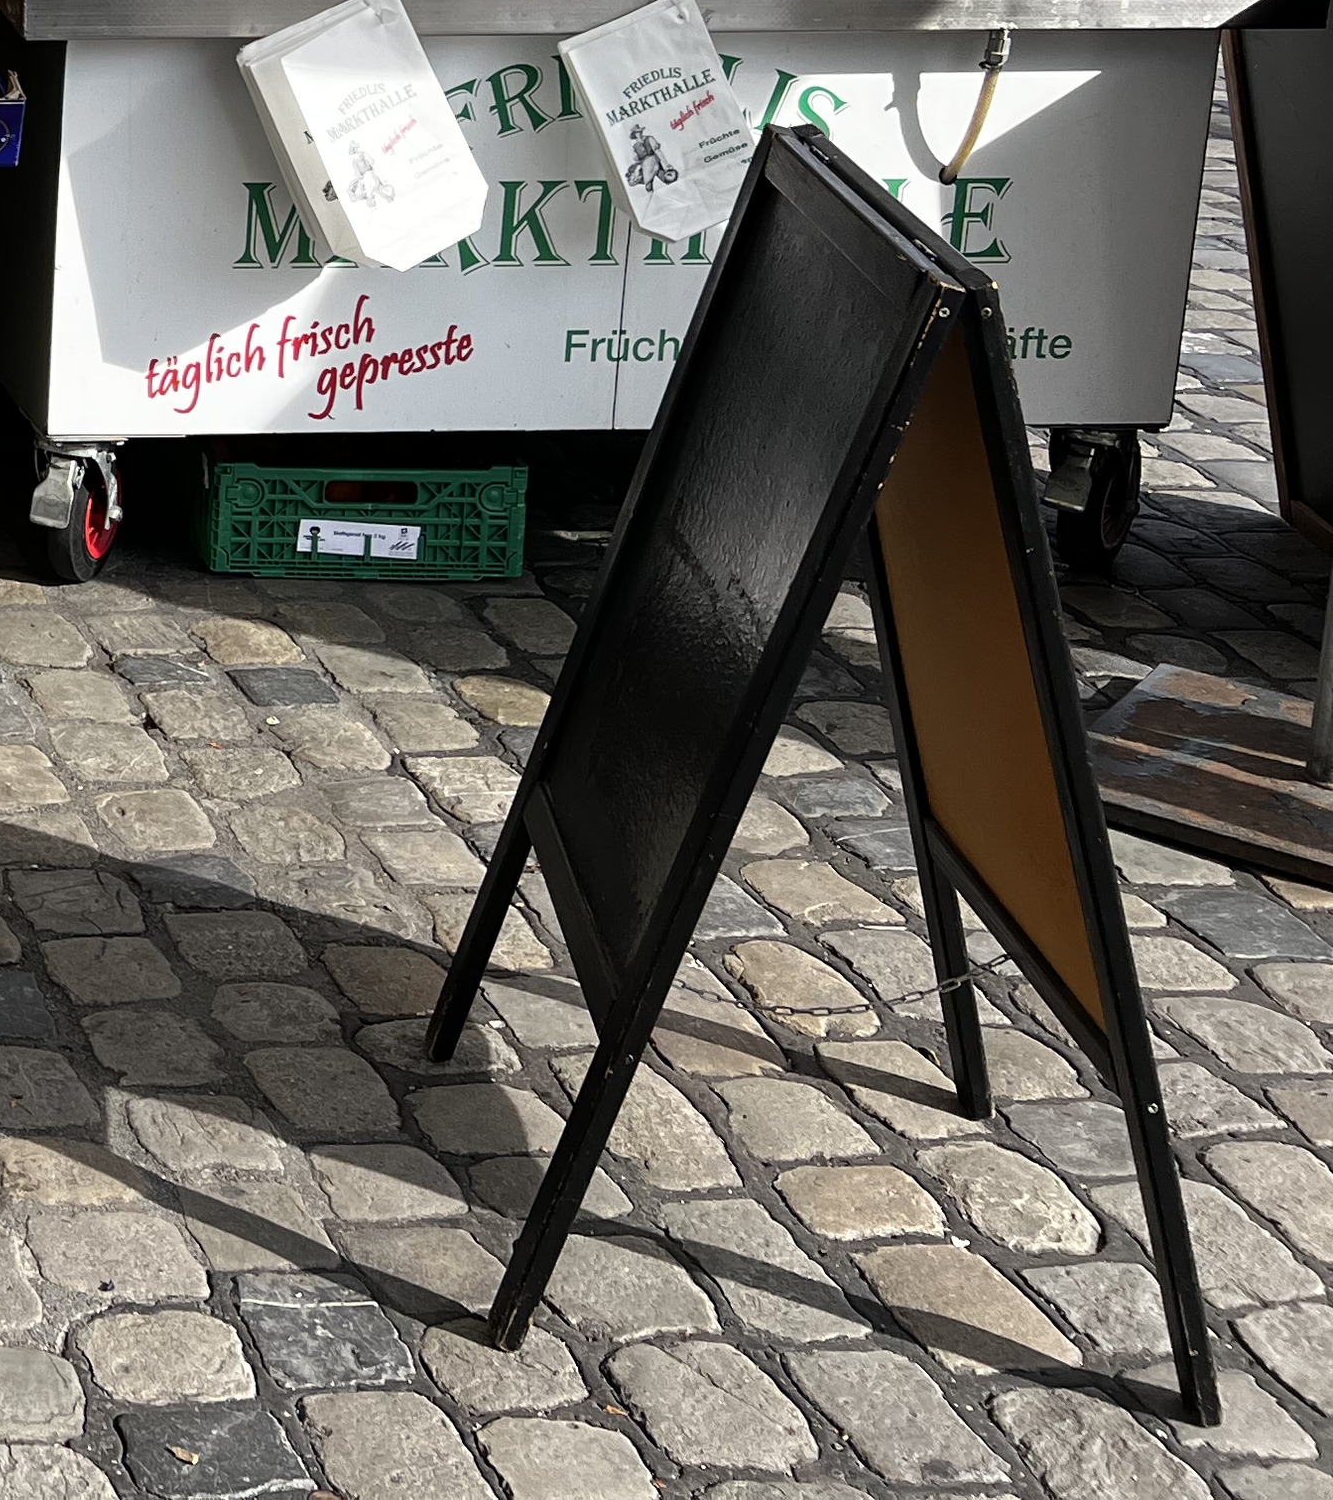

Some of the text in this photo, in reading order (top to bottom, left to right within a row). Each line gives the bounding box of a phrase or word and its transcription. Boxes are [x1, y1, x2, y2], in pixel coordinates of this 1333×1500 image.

[337, 82, 387, 116] FRIEDLIS
[605, 68, 716, 127] MARKTHALLE
[622, 67, 683, 100] FRIEDLIS
[325, 83, 418, 143] MARKTHALLE
[698, 128, 741, 149] Früchte
[703, 141, 749, 165] Gemüse
[145, 294, 376, 414] täglich frisch
[564, 328, 682, 363] Früch
[307, 324, 475, 421] gepresste
